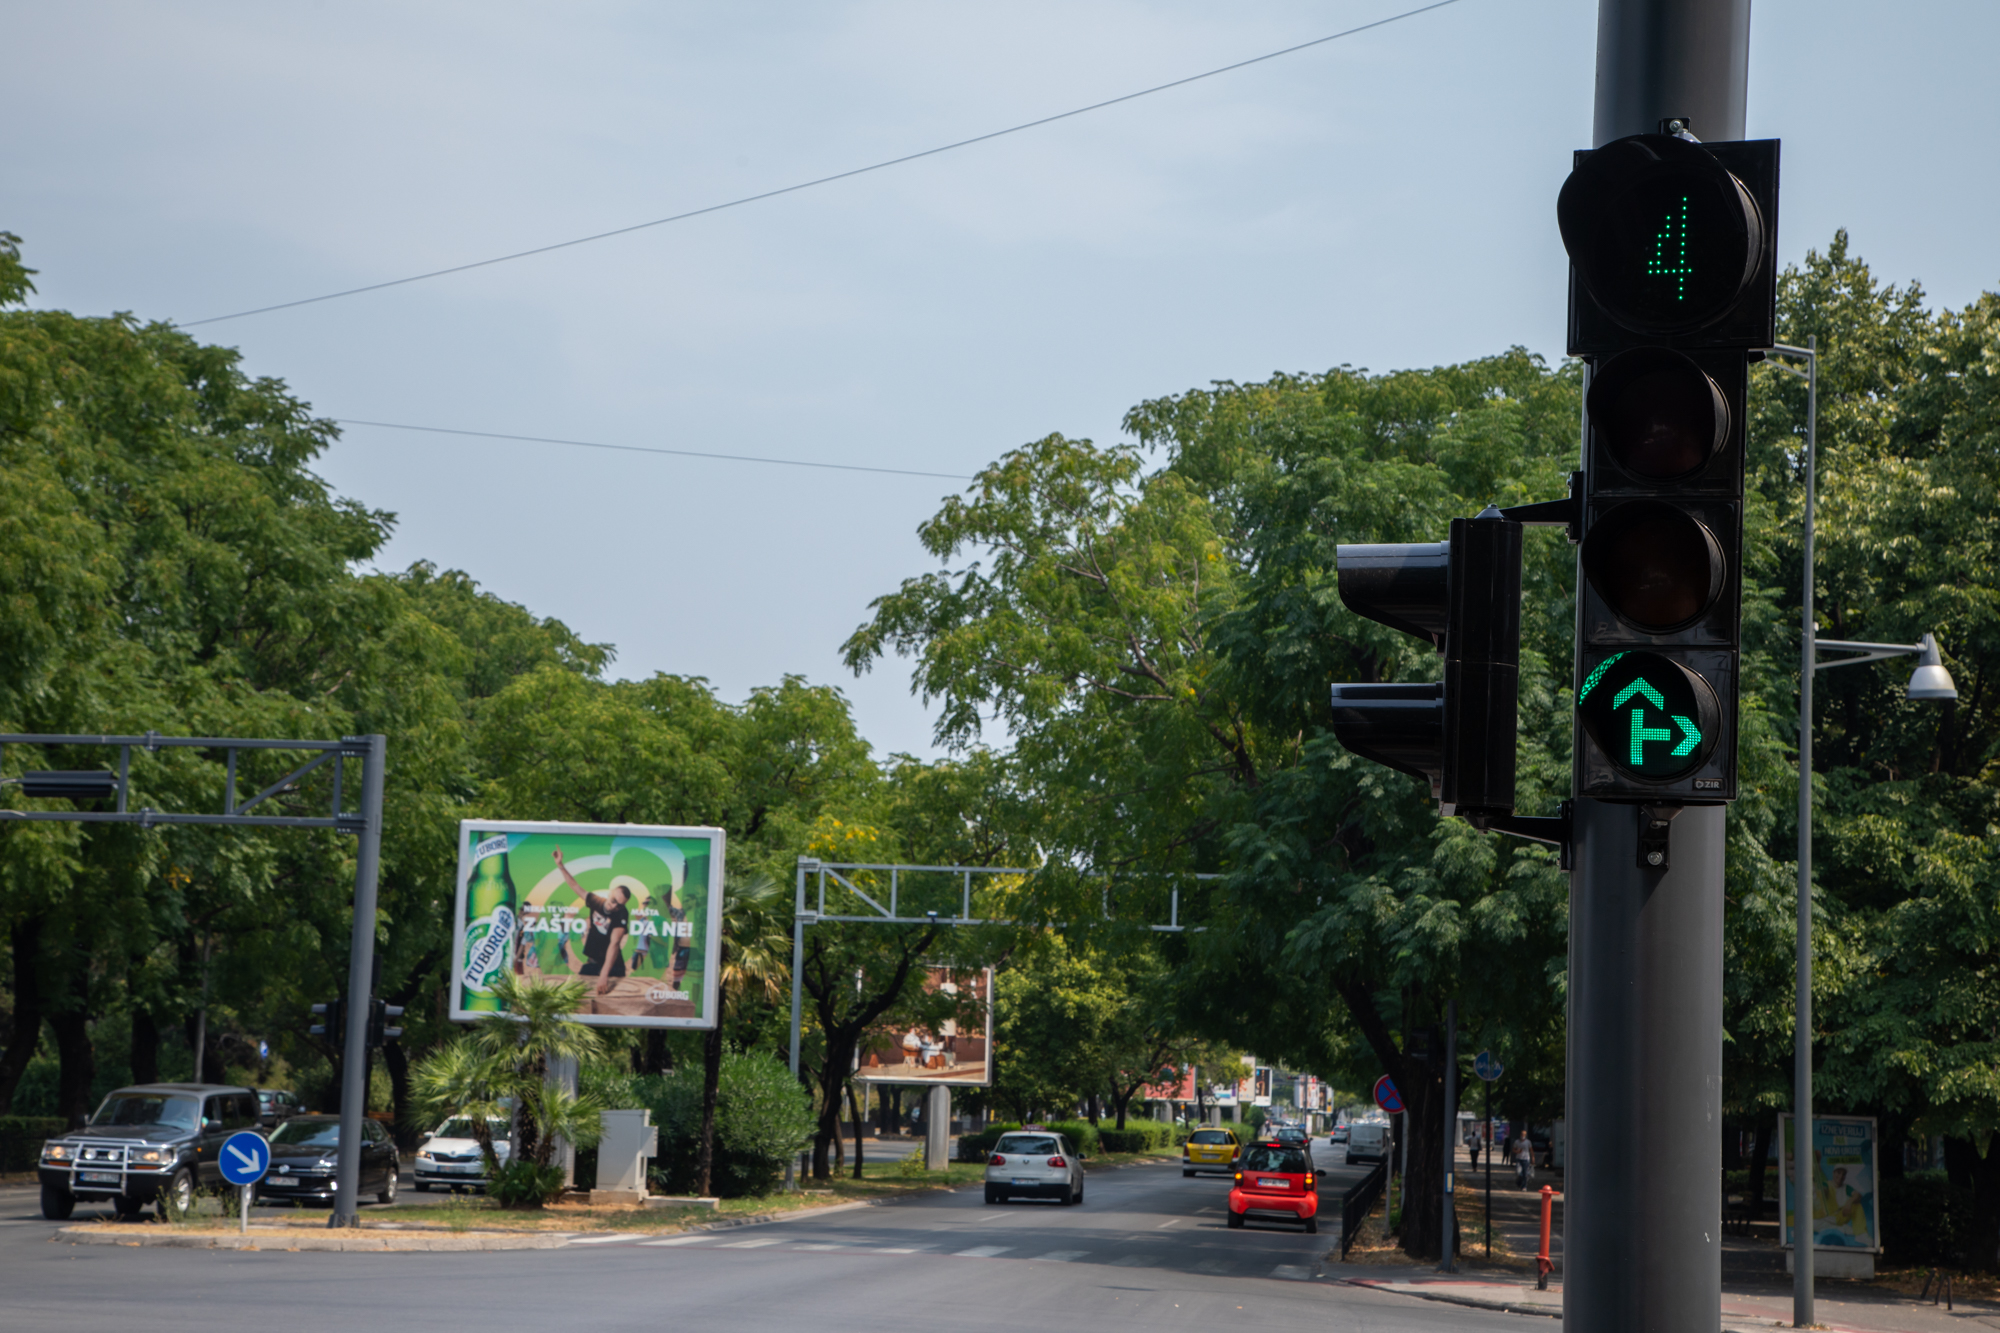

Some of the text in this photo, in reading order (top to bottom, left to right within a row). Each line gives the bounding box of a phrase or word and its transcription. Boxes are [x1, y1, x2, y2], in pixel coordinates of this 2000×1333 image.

[1648, 196, 1692, 300] 4
[1704, 781, 1720, 789] ZIR
[476, 838, 507, 858] TUBORG
[547, 906, 558, 914] TE
[630, 908, 660, 918] MAŠTA
[523, 914, 693, 937] ZAŠTO DA NE!
[465, 924, 508, 983] TUBORG
[653, 990, 689, 1001] TUBORG
